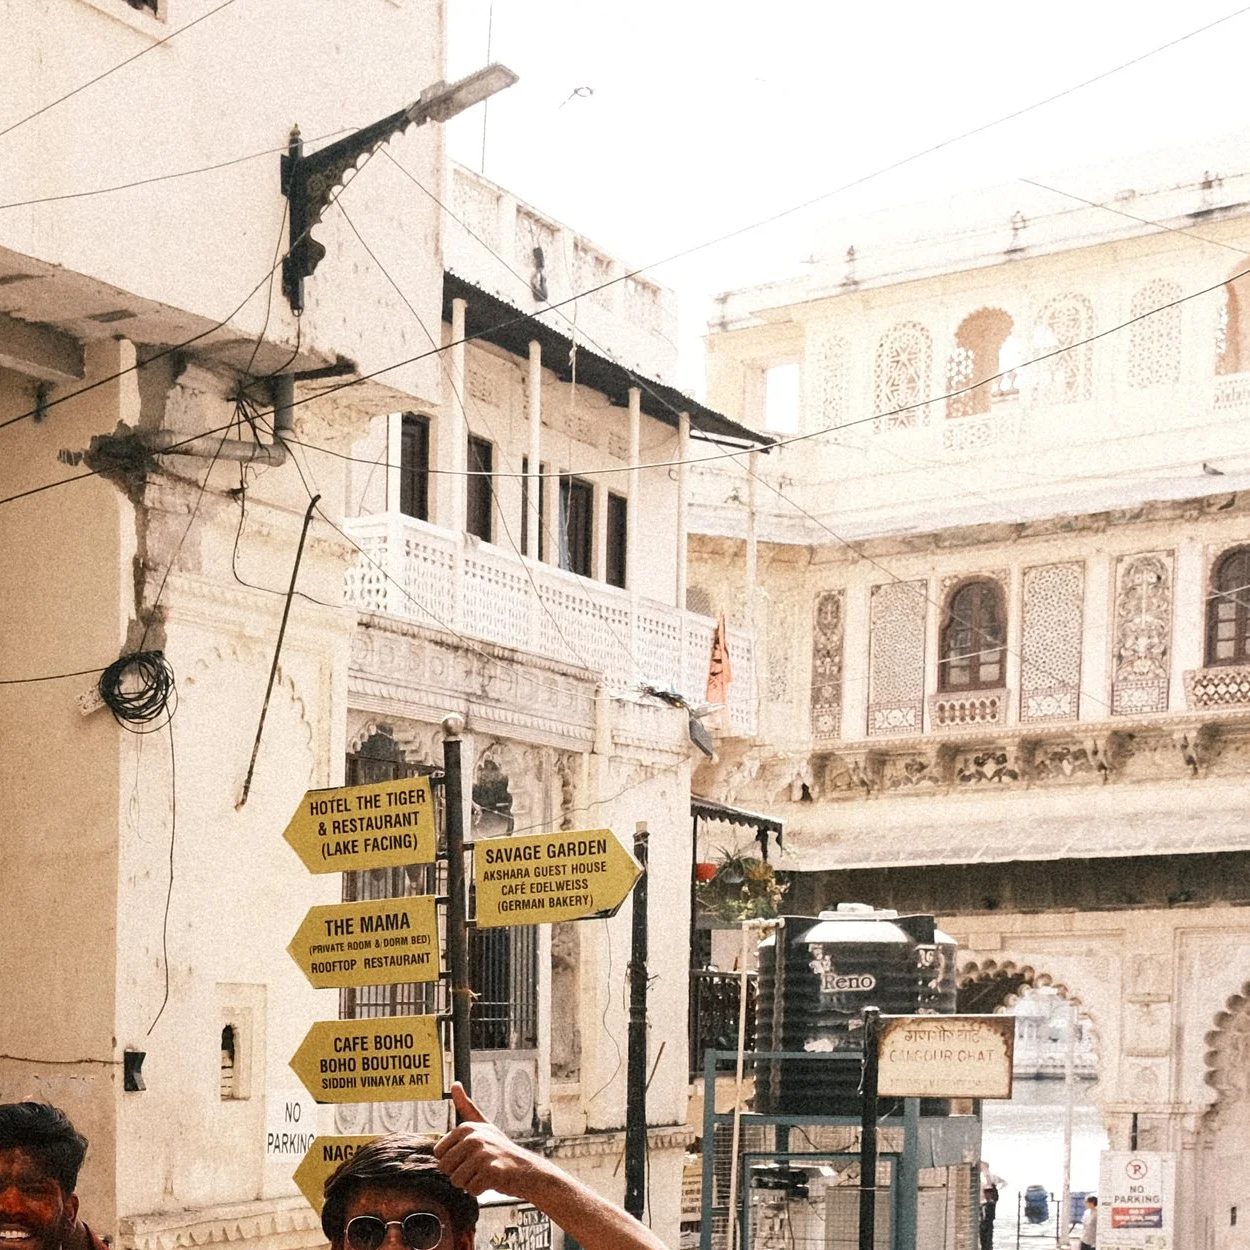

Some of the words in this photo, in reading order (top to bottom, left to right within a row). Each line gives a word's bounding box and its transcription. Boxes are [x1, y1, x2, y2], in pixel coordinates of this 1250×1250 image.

[310, 798, 351, 816] HOTEL
[356, 794, 381, 810] THE
[386, 789, 426, 807] TIGER
[318, 821, 327, 836] &
[332, 811, 420, 834] RESTAURANT
[321, 840, 359, 860] (LAKE
[364, 833, 418, 853] FACING)
[485, 845, 541, 864] SAVAGE
[547, 839, 607, 859] GARDEN
[483, 867, 530, 882] AKSHARA
[534, 864, 567, 878] GUEST
[571, 861, 607, 875] HOUSE
[501, 881, 526, 896] CAFÉ
[530, 878, 589, 894] EDELWEISS
[497, 897, 545, 914] (GERMAN
[548, 894, 594, 908] BAKERY)
[325, 918, 354, 937] THE
[360, 912, 410, 933] MAMA
[309, 942, 344, 956] (PRIVATE
[347, 940, 372, 951] ROOM
[374, 939, 380, 949] &
[383, 937, 409, 948] DORM
[411, 934, 431, 946] BED)
[311, 959, 357, 974] ROOFTOP
[364, 952, 431, 969] RESTAURANT
[823, 974, 873, 990] Reno
[333, 1036, 369, 1053] CAFE
[374, 1033, 414, 1051] BOHO
[320, 1057, 356, 1073] BOHO
[362, 1054, 430, 1071] BOUTIQUE
[321, 1077, 357, 1090] SIDDHI
[360, 1074, 406, 1088] VINAYAK
[409, 1073, 430, 1086] ART
[284, 1102, 302, 1123] NO
[1114, 1195, 1160, 1204] PARKING
[1129, 1185, 1144, 1194] NO
